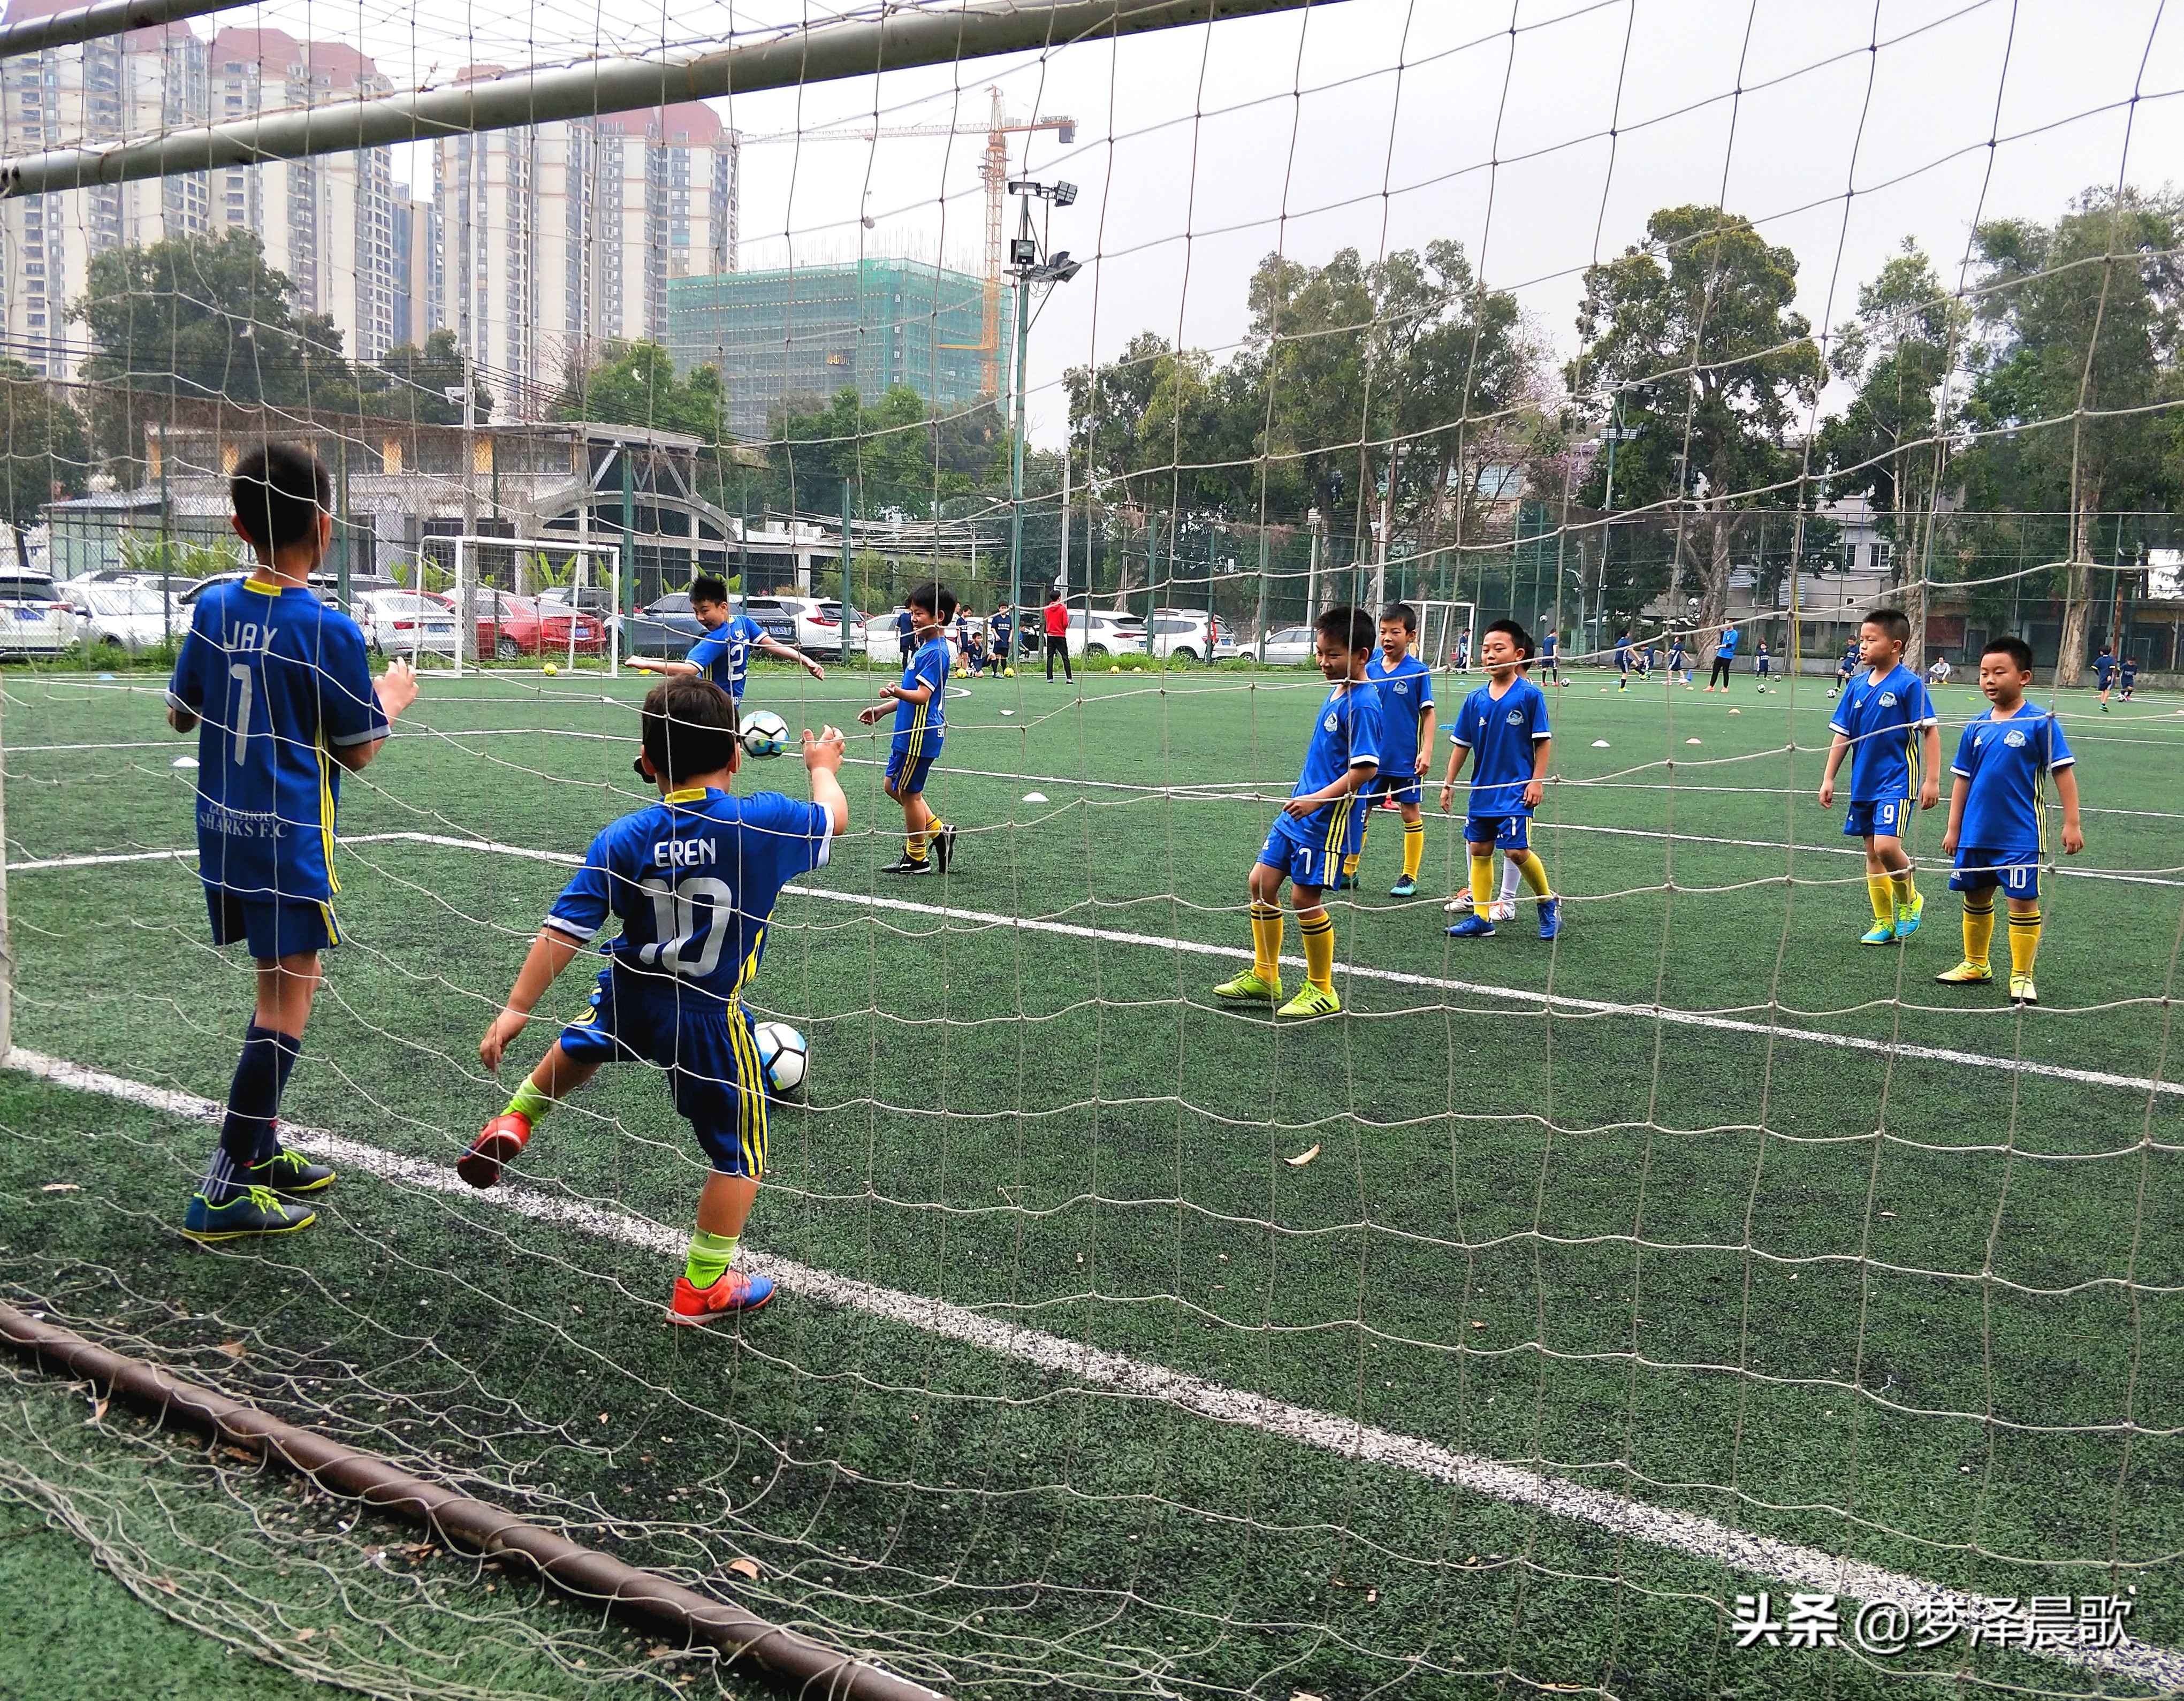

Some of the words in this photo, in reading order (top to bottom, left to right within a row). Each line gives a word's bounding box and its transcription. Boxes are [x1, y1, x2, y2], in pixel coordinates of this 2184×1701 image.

[223, 621, 278, 655] JAY
[200, 812, 254, 837] SHARKS
[1884, 804, 1894, 824] 9
[655, 838, 716, 867] EREN
[2008, 867, 2027, 889] 10
[639, 877, 732, 977] 10
